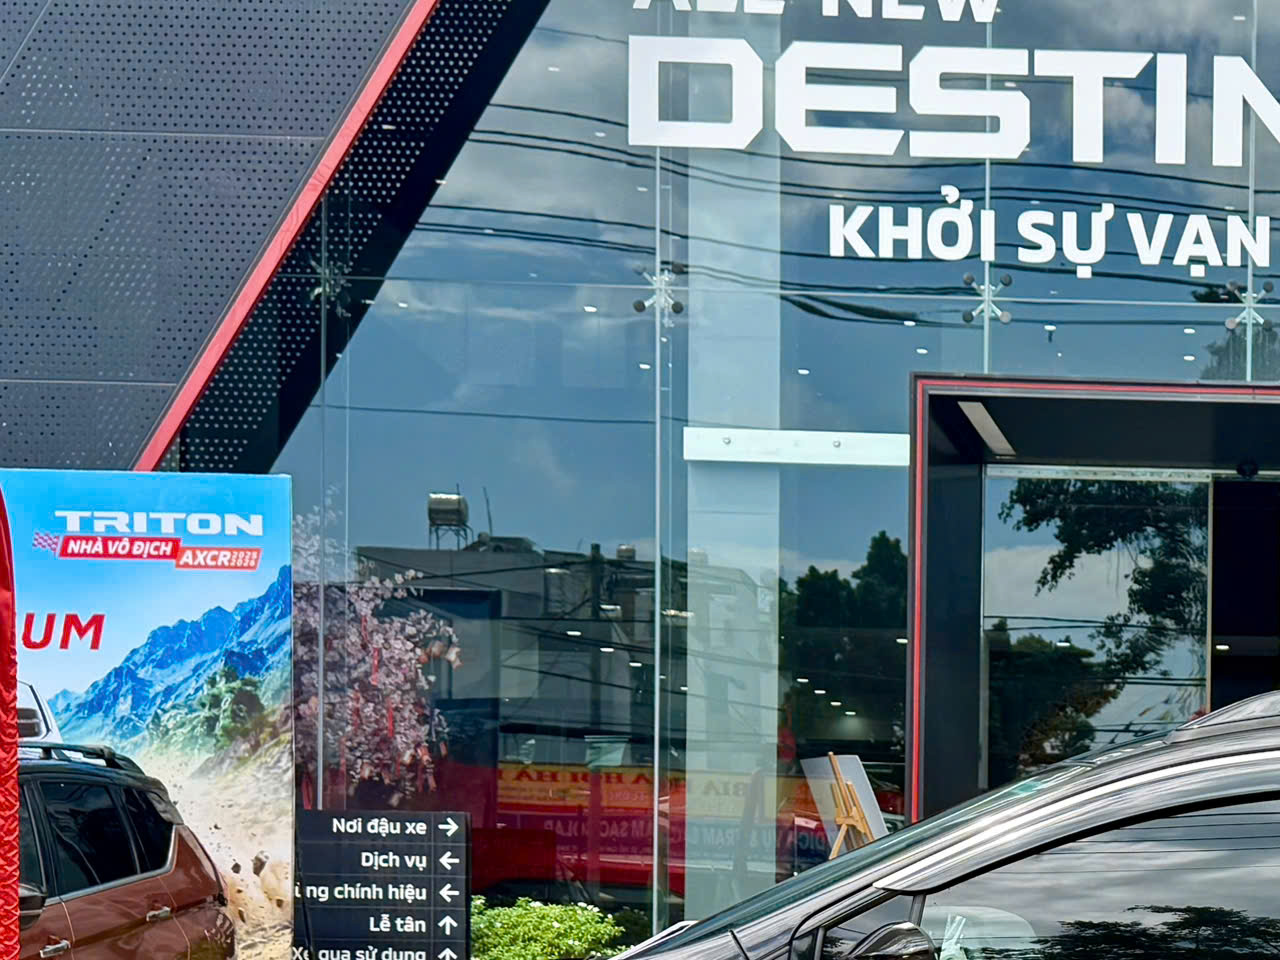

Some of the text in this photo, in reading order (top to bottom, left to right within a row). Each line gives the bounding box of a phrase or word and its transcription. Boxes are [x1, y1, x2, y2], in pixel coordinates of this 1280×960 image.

[828, 184, 996, 262] KHỞI
[1016, 202, 1115, 279] SỰ
[1126, 212, 1271, 278] VẠN
[54, 510, 264, 537] TRITON
[67, 538, 173, 559] NHÀ VÔ ĐỊCH
[179, 549, 231, 567] AXCR
[21, 612, 106, 650] UM
[332, 817, 427, 837] Nơi đậu xe
[361, 851, 427, 871] Dịch vụ
[333, 882, 383, 900] chính
[388, 883, 427, 903] hiệu
[369, 914, 427, 933] Lễ tân
